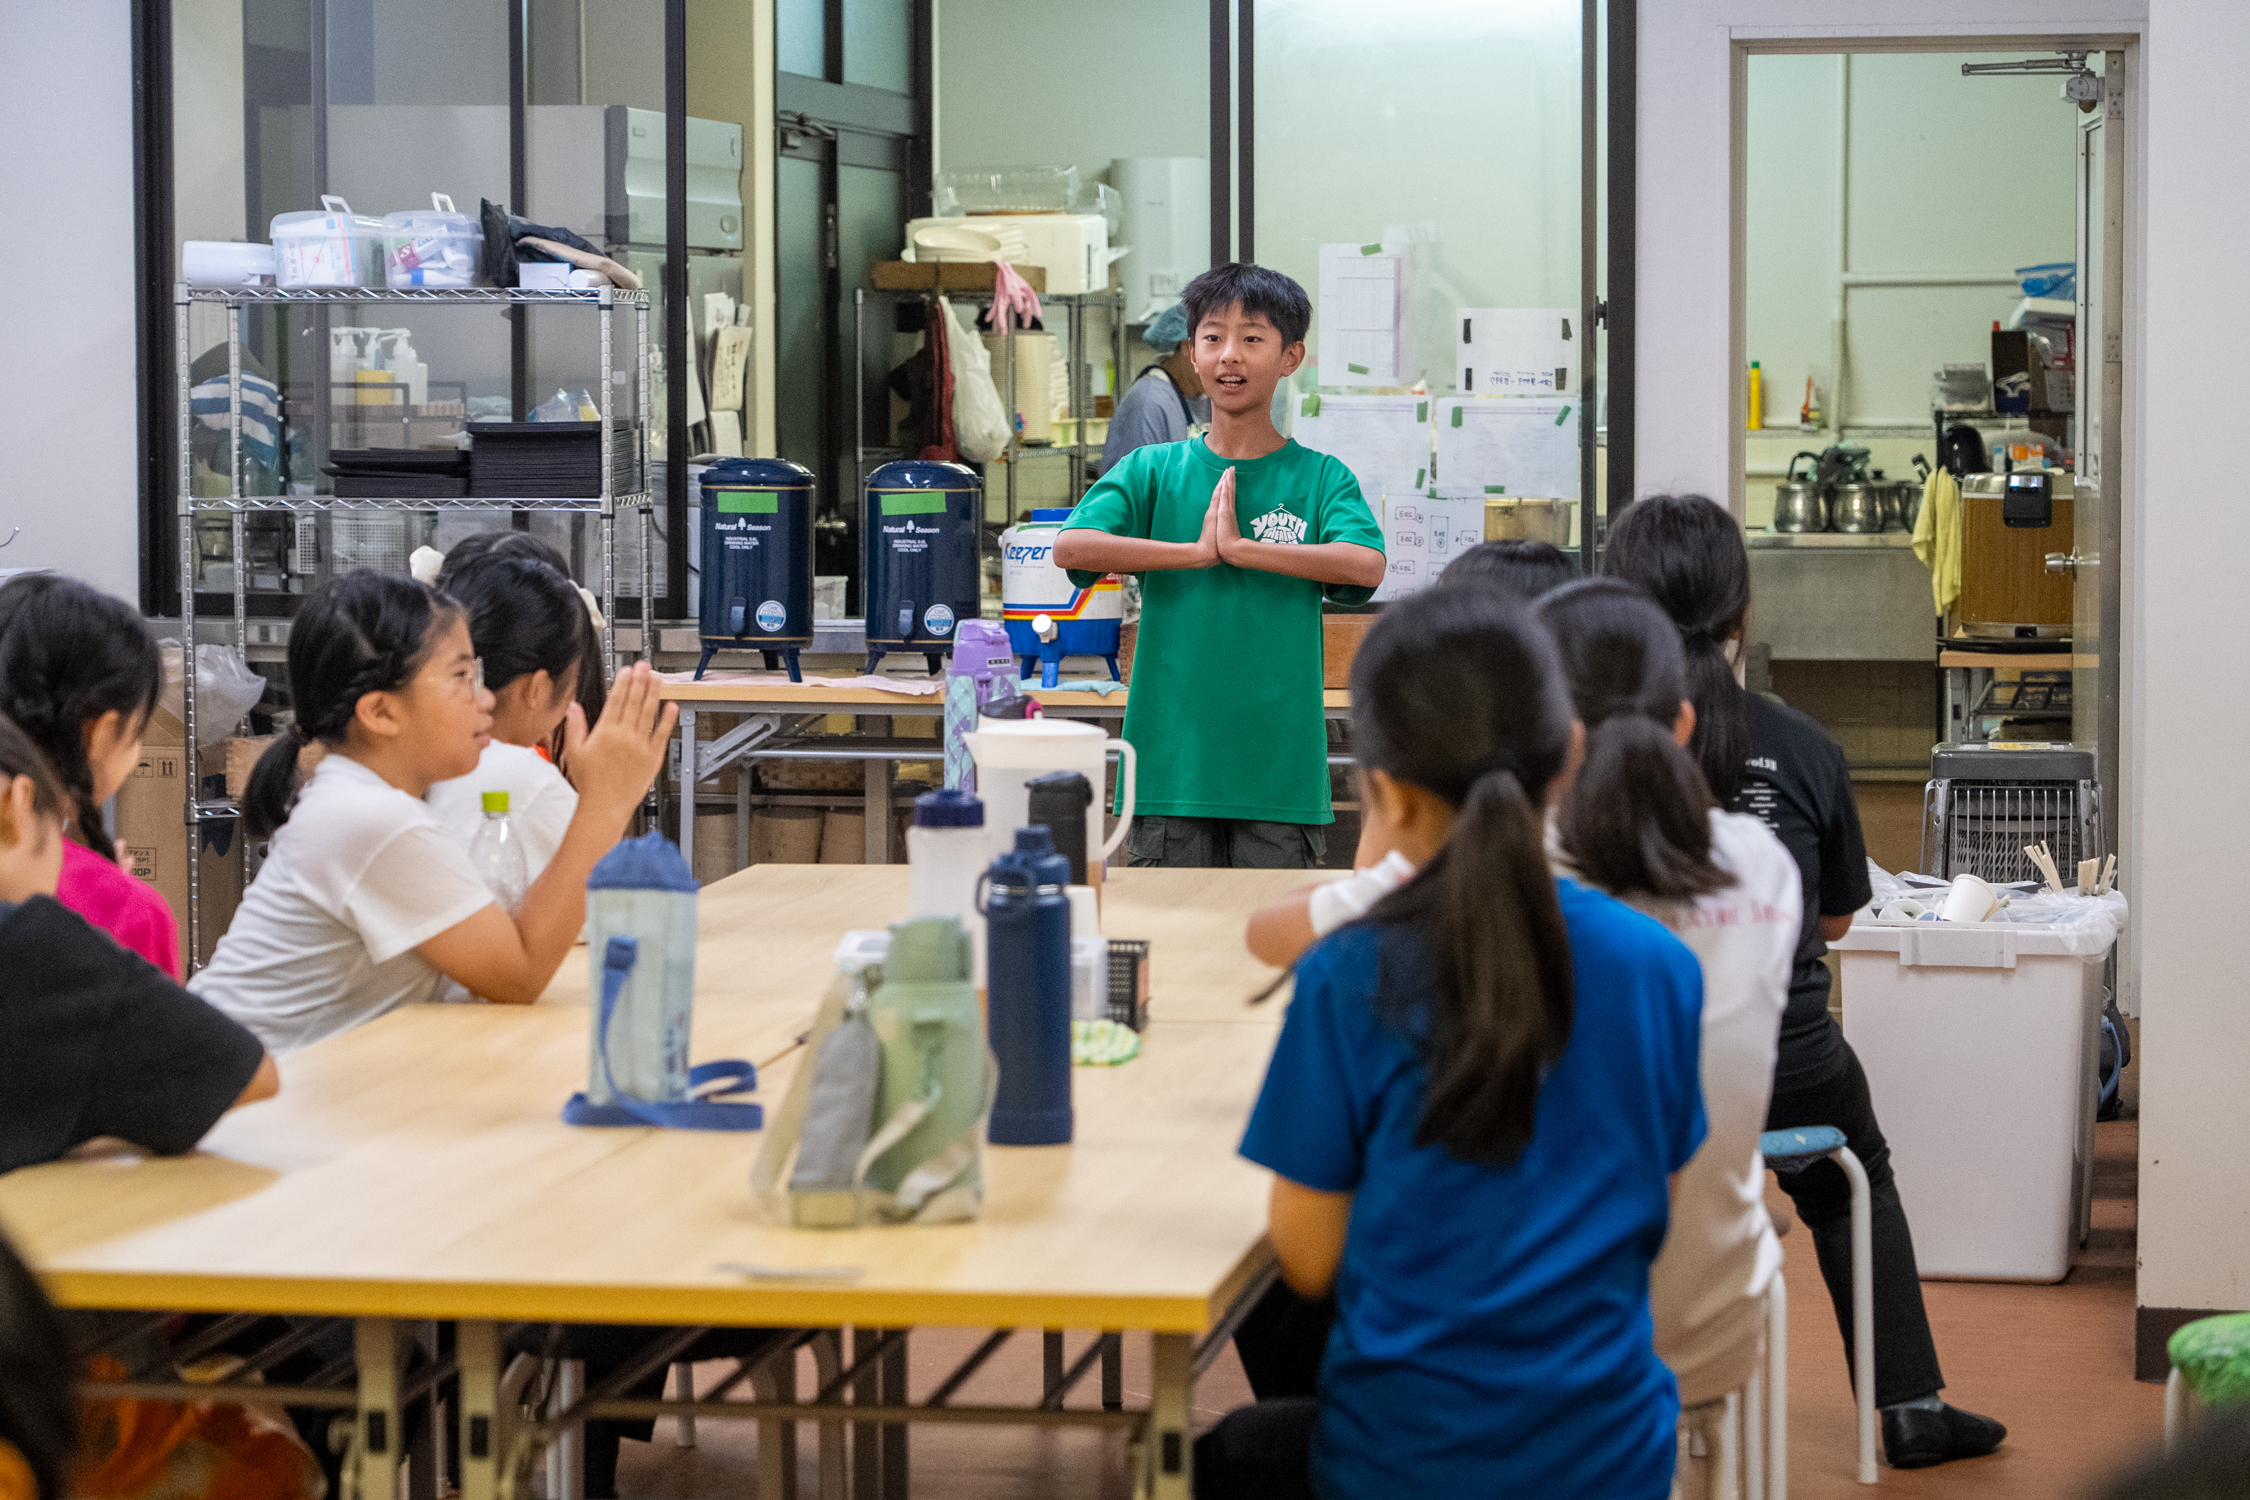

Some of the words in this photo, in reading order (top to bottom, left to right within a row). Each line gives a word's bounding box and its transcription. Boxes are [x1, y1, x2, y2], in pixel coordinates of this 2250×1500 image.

[715, 522, 737, 531] Natural
[747, 523, 772, 531] Season
[883, 525, 905, 533] Natural
[915, 526, 940, 534] Season
[1250, 513, 1308, 542] YOUTH
